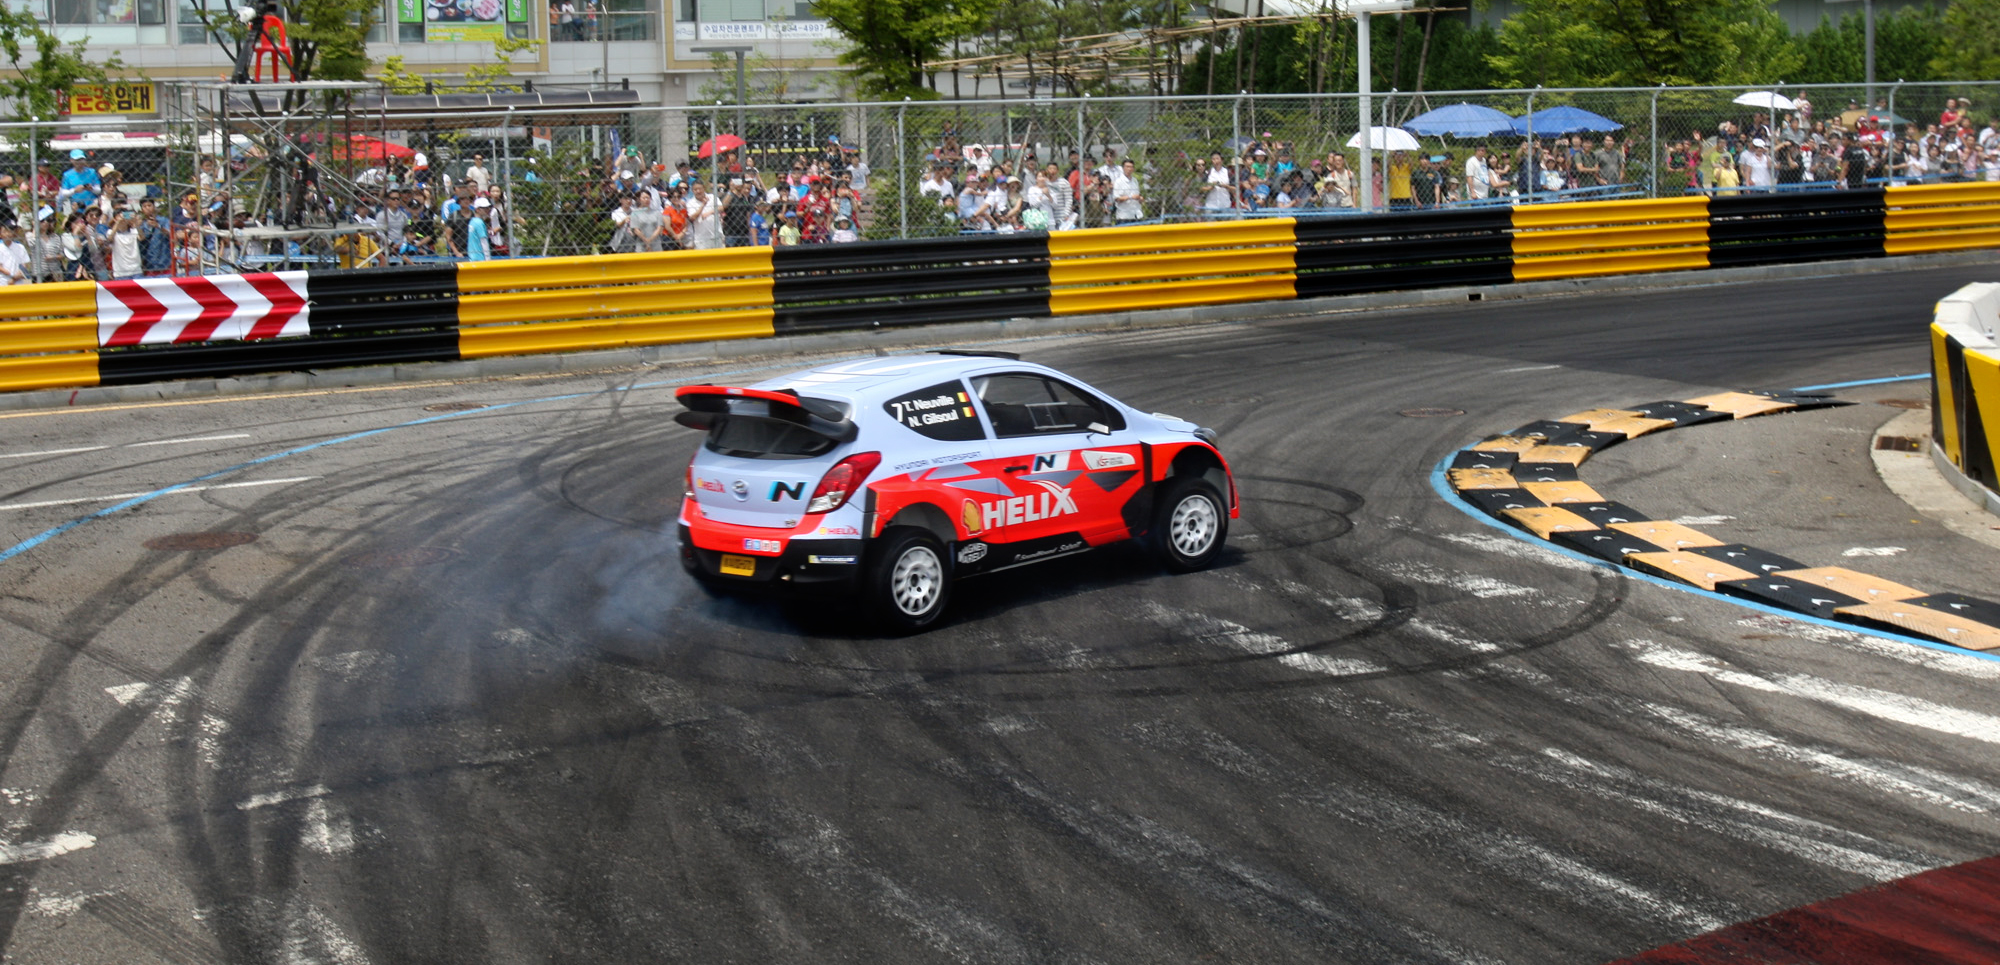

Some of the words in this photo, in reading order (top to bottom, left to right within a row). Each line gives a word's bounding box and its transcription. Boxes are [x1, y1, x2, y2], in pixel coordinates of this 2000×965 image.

[901, 401, 914, 412] T.
[912, 395, 955, 411] Neuville
[891, 403, 903, 423] 7
[908, 416, 922, 428] N.
[921, 409, 959, 425] Gilsoul
[931, 450, 982, 464] MOTORSPORT
[1033, 454, 1056, 471] N
[767, 482, 808, 502] N
[981, 480, 1079, 530] HELIX
[827, 525, 860, 536] HELIX
